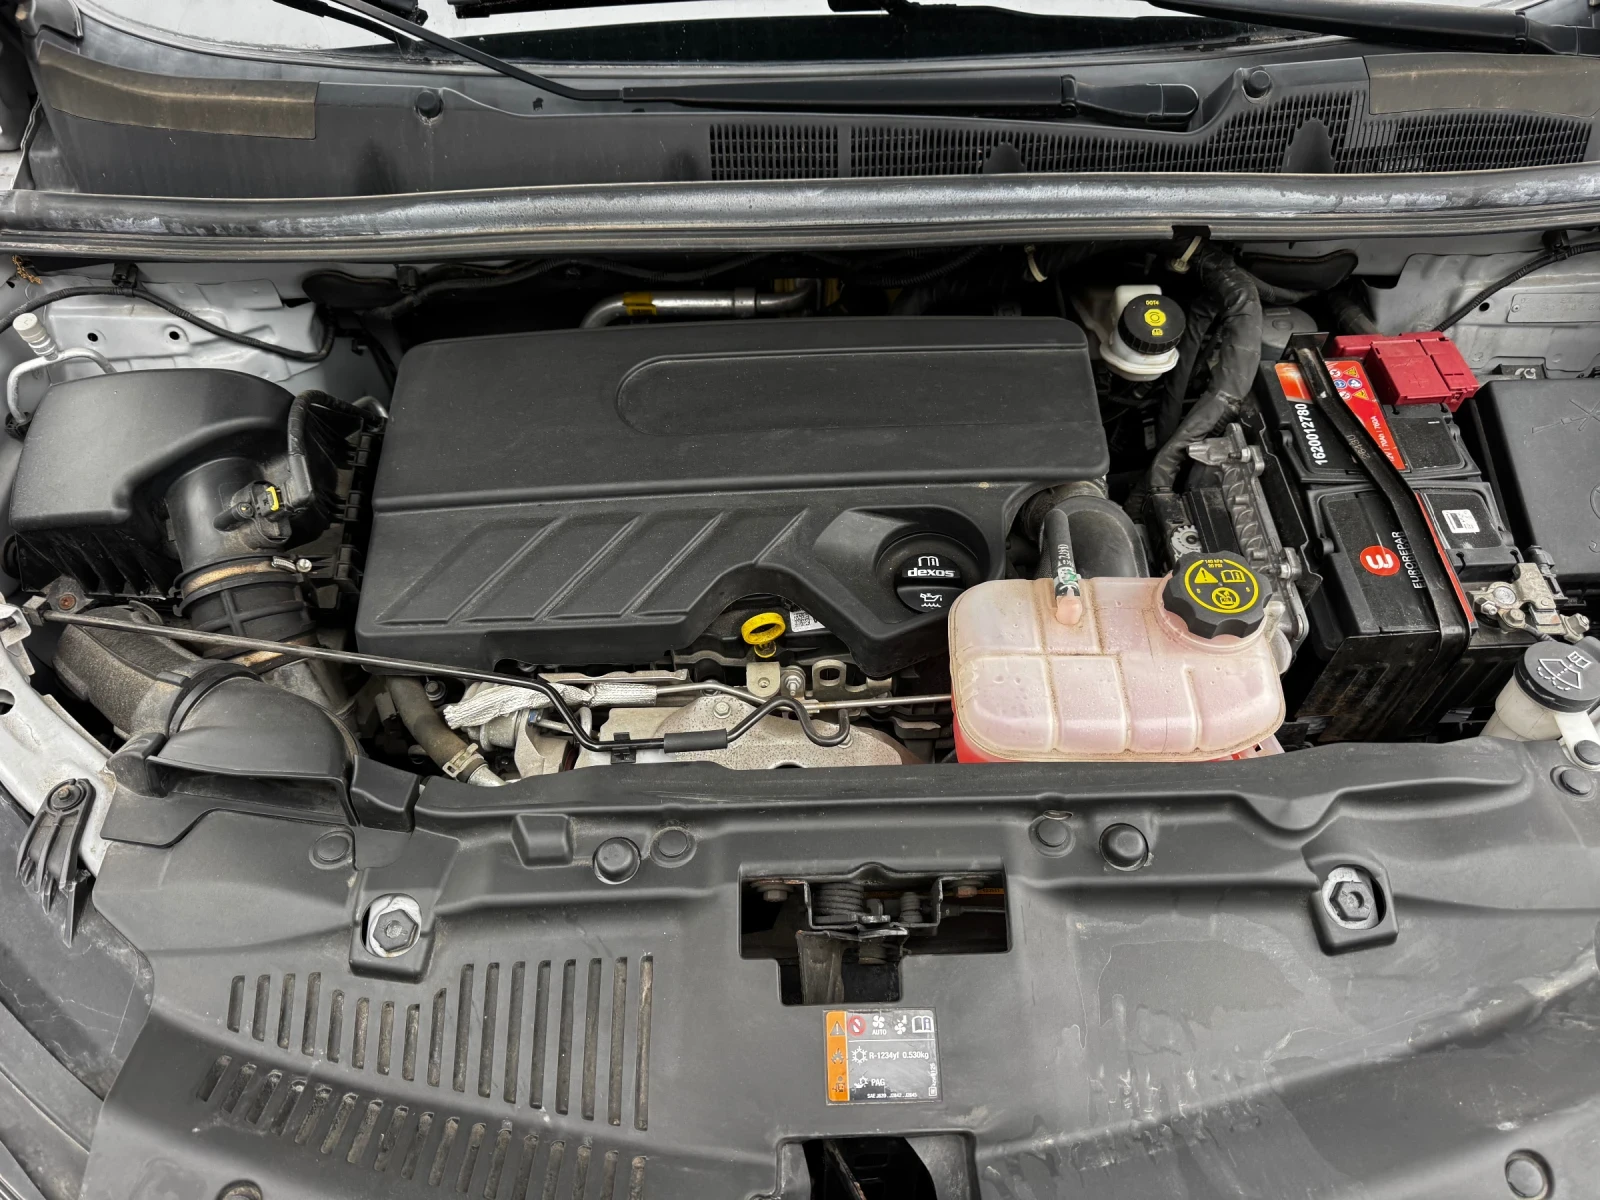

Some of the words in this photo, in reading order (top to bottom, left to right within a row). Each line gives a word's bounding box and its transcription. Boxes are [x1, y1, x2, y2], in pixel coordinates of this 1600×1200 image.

[1294, 403, 1329, 466] 1620012780
[1391, 531, 1423, 589] EUROREPAR
[907, 567, 956, 578] dexos
[869, 1052, 900, 1060] R-1234yf
[902, 1052, 929, 1060] 0.530kg
[870, 1078, 886, 1087] PAG
